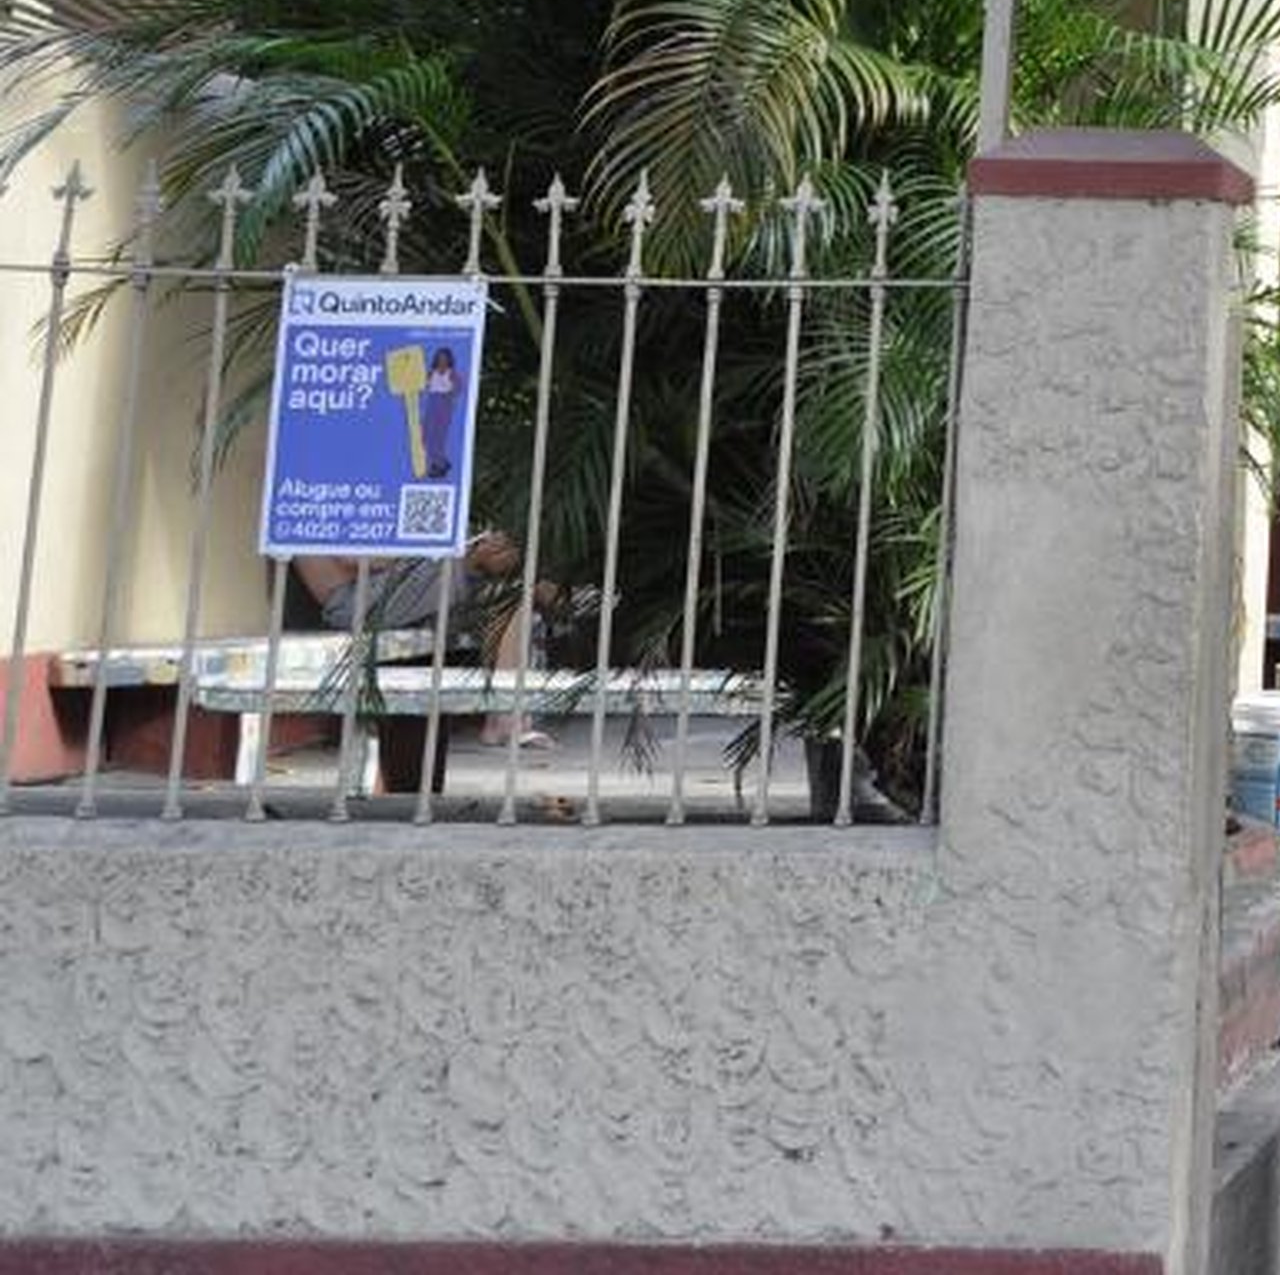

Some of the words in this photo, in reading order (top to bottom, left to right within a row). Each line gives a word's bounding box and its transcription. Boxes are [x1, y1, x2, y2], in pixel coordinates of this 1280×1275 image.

[319, 290, 477, 316] QuintoAndar
[294, 333, 370, 360] Quer
[291, 363, 382, 383] morar
[289, 385, 373, 413] aqui?
[277, 479, 350, 502] Alugue
[355, 482, 381, 499] ou
[276, 502, 356, 520] compre
